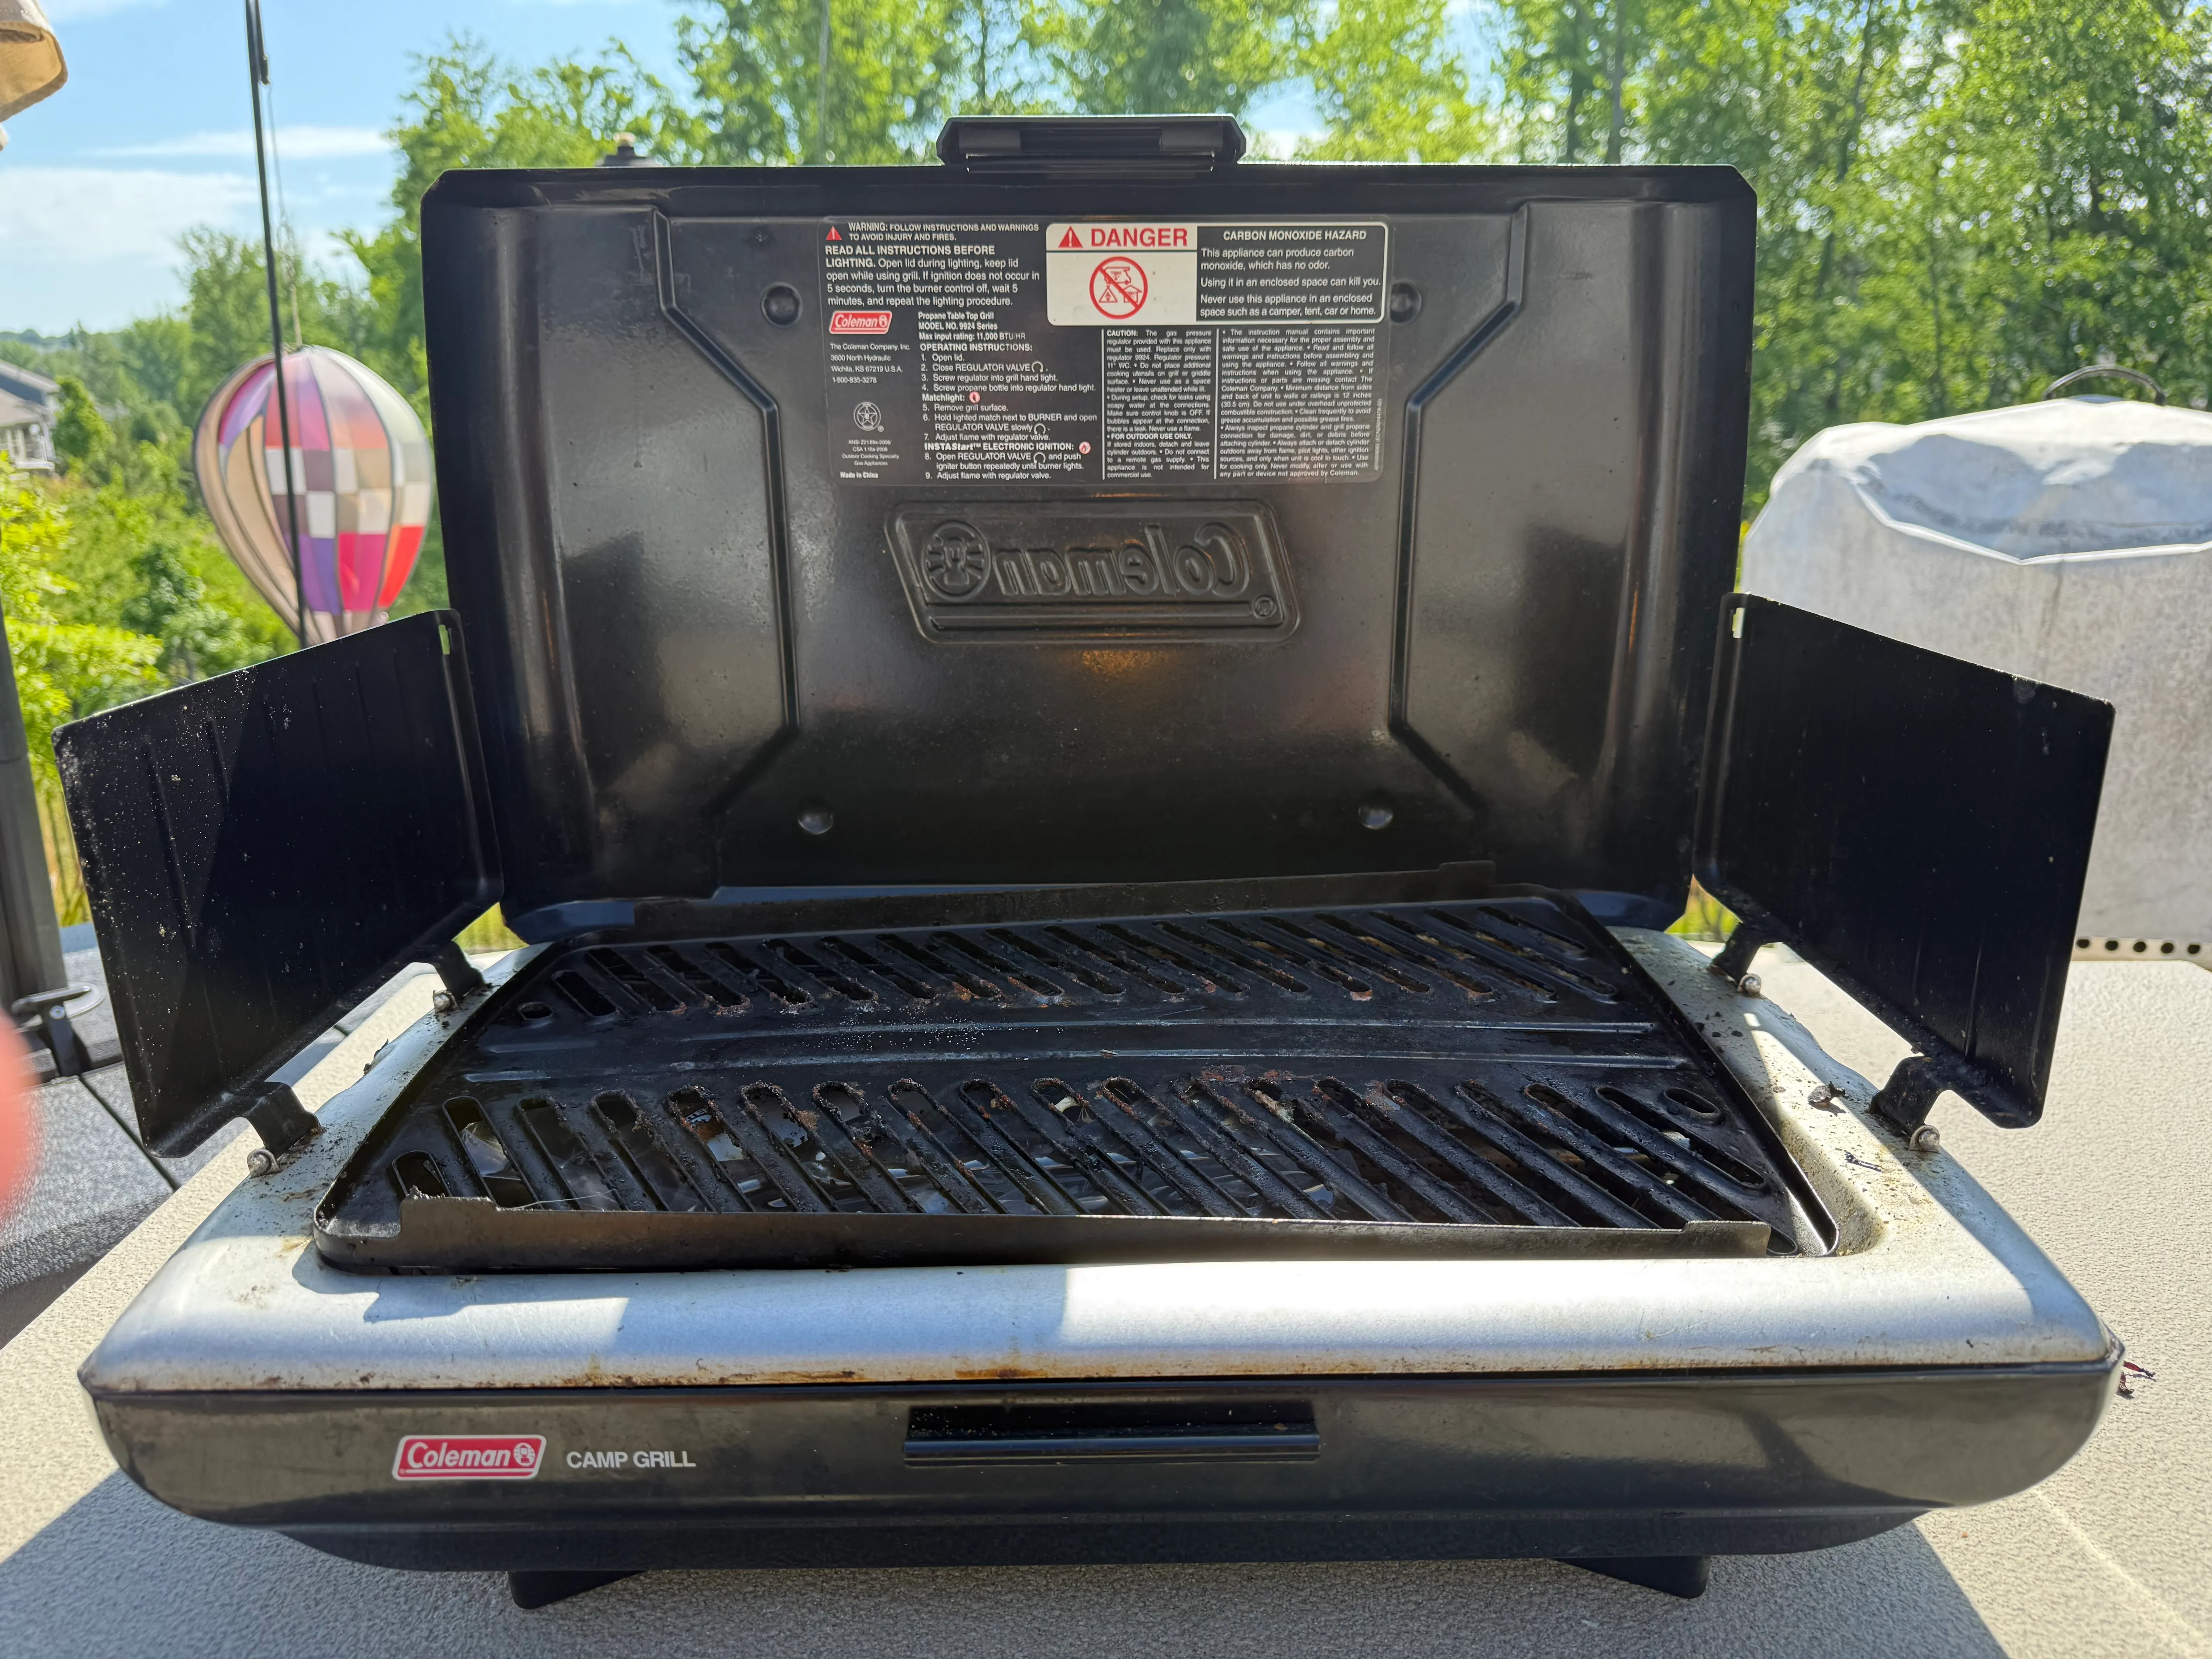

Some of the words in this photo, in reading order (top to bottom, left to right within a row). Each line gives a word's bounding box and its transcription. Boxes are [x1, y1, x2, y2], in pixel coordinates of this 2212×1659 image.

[848, 221, 888, 231] WARNING:
[889, 223, 921, 232] FOLLOW
[980, 223, 997, 231] AND
[997, 223, 1039, 231] WARNINGS
[848, 233, 860, 241] TO
[861, 232, 884, 240] AVOID
[1091, 228, 1188, 247] DANGER
[1223, 230, 1266, 240] CARBON
[1269, 230, 1322, 240] MONOXIDE
[1324, 230, 1367, 240] HAZARD
[825, 245, 853, 255] READ
[855, 245, 875, 255] ALL
[877, 245, 951, 255] INSTRUCTIONS
[954, 245, 995, 255] BEFORE
[1201, 247, 1220, 257] This
[1222, 248, 1265, 259] appliance
[1285, 247, 1321, 259] produce
[1323, 247, 1354, 256] carbon
[825, 258, 876, 268] LIGHTING.
[878, 258, 903, 270] Open
[905, 258, 915, 268] lid
[917, 258, 946, 270] during
[948, 258, 982, 270] lighting,
[984, 258, 1006, 270] keep
[1008, 258, 1018, 268] lid
[1201, 260, 1245, 271] monoxide,
[1248, 260, 1274, 270] which
[1276, 260, 1292, 270] has
[1295, 261, 1306, 270] no
[1308, 259, 1330, 270] odor.
[826, 272, 848, 282] open
[850, 271, 874, 280] while
[876, 271, 900, 282] using
[902, 271, 921, 282] grill.
[922, 271, 928, 280] If
[931, 271, 962, 282] ignition
[964, 271, 986, 280] does
[989, 271, 1003, 280] not
[1032, 271, 1040, 280] in
[1201, 277, 1226, 289] Using
[1228, 277, 1233, 287] it
[1236, 277, 1244, 287] in
[1259, 276, 1300, 287] enclosed
[1301, 278, 1328, 289] space
[1349, 276, 1361, 286] kill
[1363, 278, 1381, 289] you.
[827, 283, 833, 293] 5
[835, 283, 874, 294] seconds,
[877, 284, 895, 293] turn
[896, 283, 911, 293] the
[913, 283, 943, 293] burner
[944, 283, 974, 293] control
[976, 283, 989, 294] off,
[992, 283, 1010, 293] wait
[1012, 283, 1018, 293] 5
[828, 296, 864, 306] minutes,
[867, 296, 884, 306] and
[886, 296, 914, 307] repeat
[916, 296, 931, 306] the
[933, 296, 964, 307] lighting
[966, 296, 1013, 307] procedure.
[1200, 294, 1226, 304] Never
[1247, 294, 1262, 303] this
[1264, 294, 1307, 305] appliance
[1309, 293, 1317, 303] in
[1333, 293, 1373, 302] enclosed
[918, 311, 946, 321] Propane
[946, 311, 965, 319] Table
[965, 311, 979, 321] Top
[979, 311, 994, 319] Grill
[1200, 308, 1226, 318] space
[1227, 306, 1247, 316] such
[1269, 307, 1302, 318] camper,
[1304, 306, 1322, 316] tent,
[1324, 307, 1338, 315] car
[1340, 307, 1349, 315] or
[1350, 306, 1376, 315] home.
[835, 314, 878, 328] Coleman
[918, 321, 944, 330] MODEL
[945, 321, 958, 330] NO.
[959, 321, 975, 330] 9924
[976, 321, 998, 330] Series
[934, 332, 952, 342] input
[953, 332, 975, 342] rating:
[920, 343, 968, 351] OPERATING
[969, 342, 1032, 351] INSTRUCTIONS:
[932, 353, 952, 363] Open
[954, 353, 965, 361] lid.
[921, 363, 928, 371] 2.
[932, 363, 953, 371] Close
[955, 363, 1004, 371] REGULATOR
[1005, 363, 1030, 371] VALVE
[921, 373, 928, 381] 3.
[933, 373, 955, 381] Screw
[957, 374, 989, 383] regulator
[1005, 374, 1018, 383] grill
[1040, 374, 1058, 383] tight.
[922, 393, 965, 403] Matchlight:
[407, 1441, 511, 1468] Coleman
[566, 1451, 628, 1468] CAMP
[633, 1451, 696, 1468] GRILL
